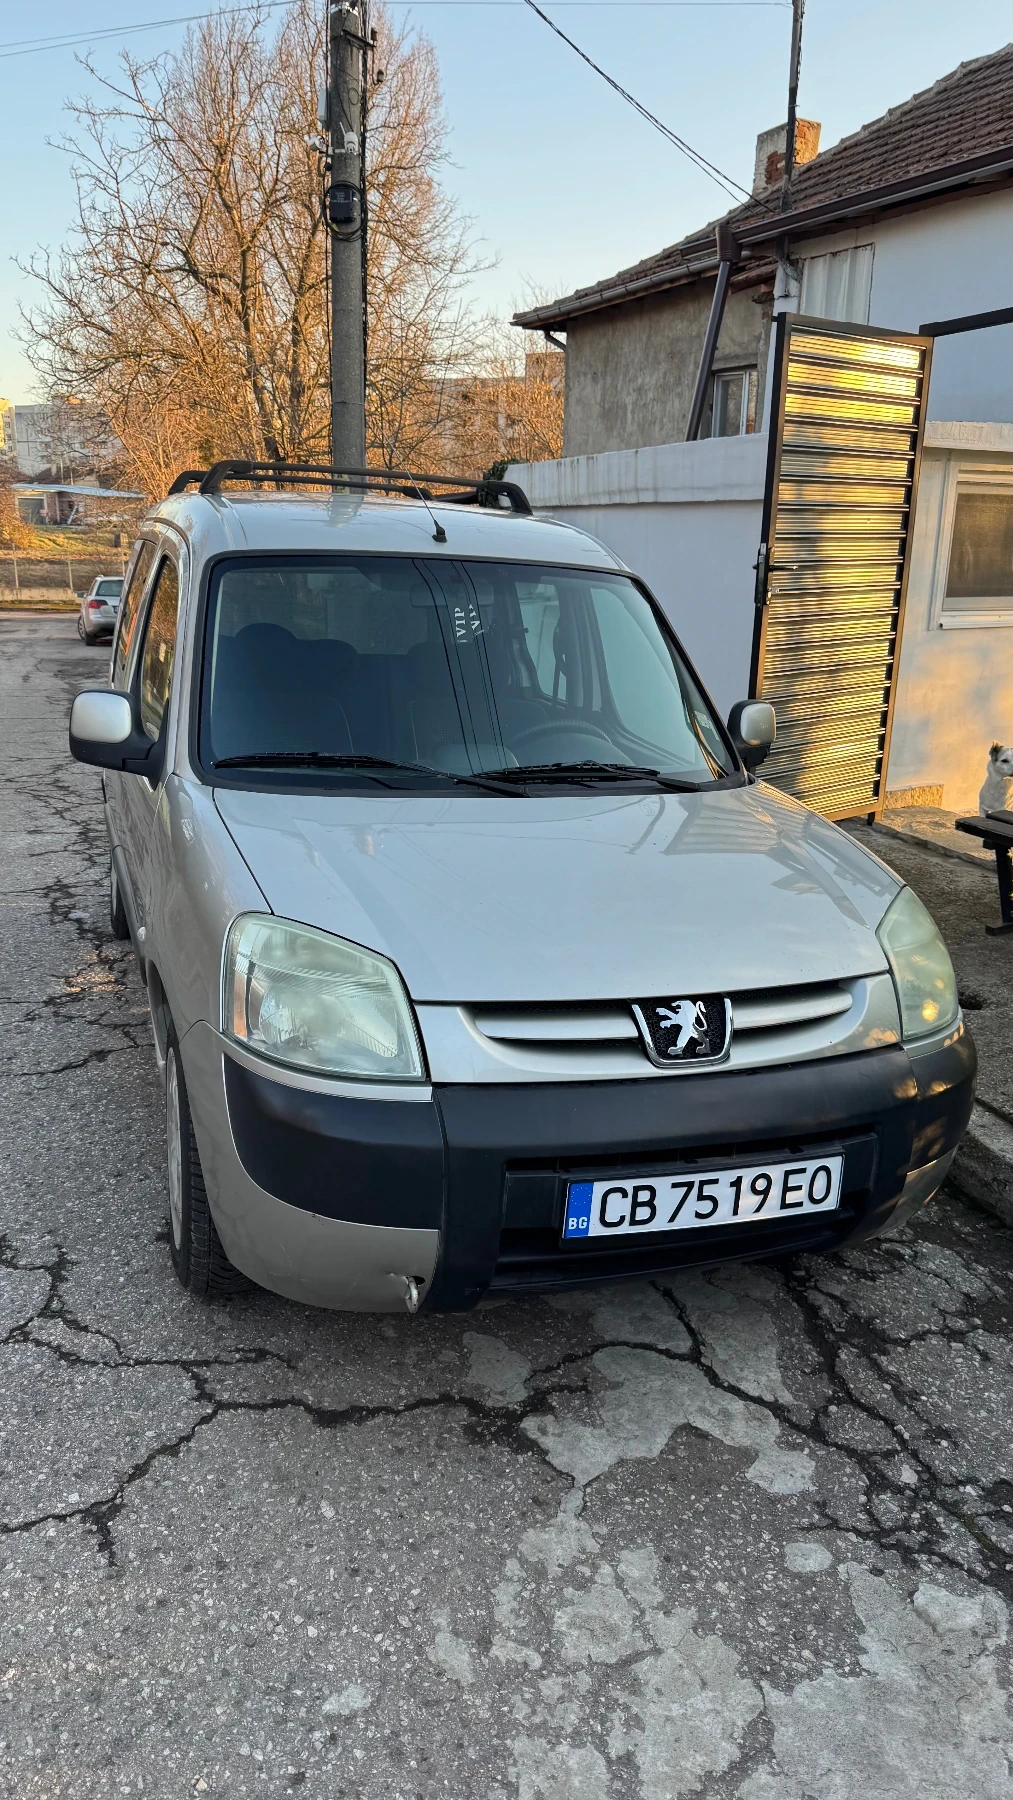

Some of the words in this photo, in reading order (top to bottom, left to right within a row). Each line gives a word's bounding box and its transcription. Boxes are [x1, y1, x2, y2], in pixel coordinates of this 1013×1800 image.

[454, 607, 466, 638] VIP
[599, 1185, 657, 1228] CB
[667, 1172, 773, 1223] 7519
[567, 1216, 588, 1230] BG
